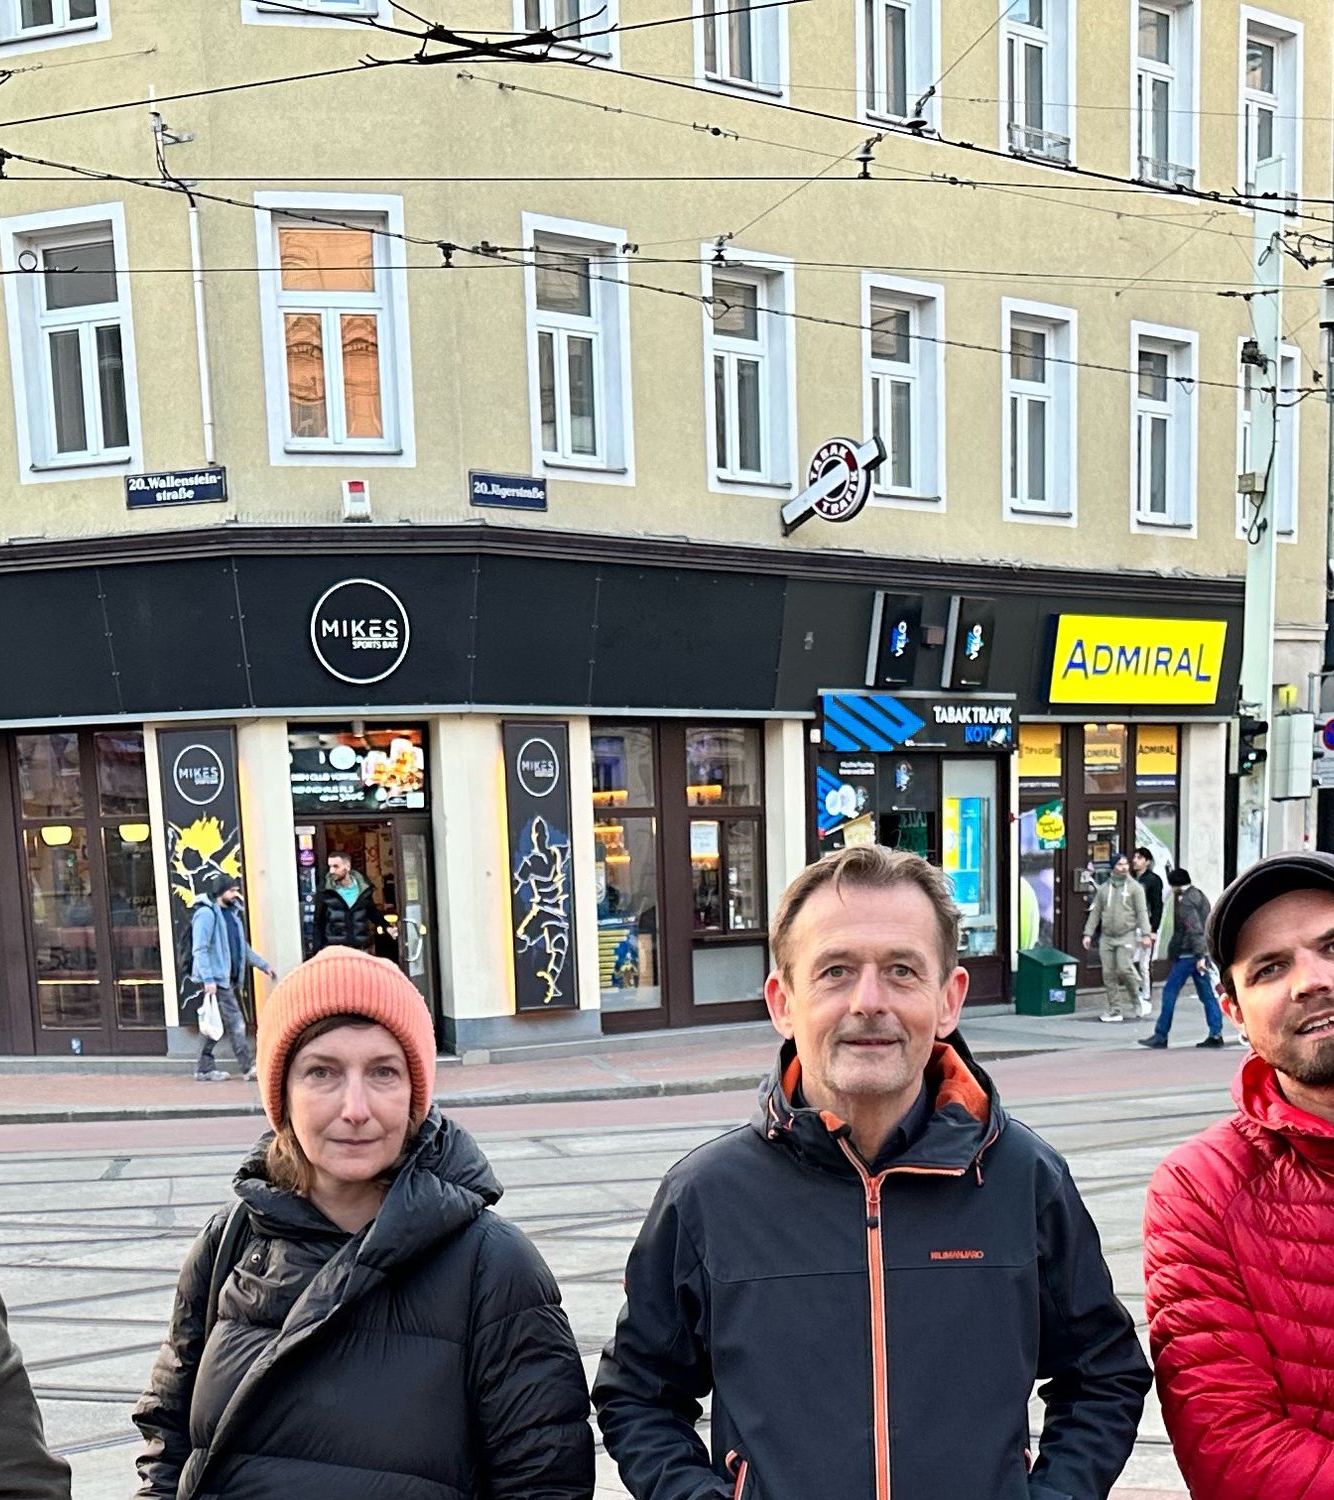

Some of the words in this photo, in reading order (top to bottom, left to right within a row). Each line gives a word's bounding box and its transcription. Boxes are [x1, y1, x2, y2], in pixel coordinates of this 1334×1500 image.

[811, 444, 848, 480] TABAK
[155, 487, 195, 501] straße
[822, 470, 858, 514] TRAFIK
[321, 619, 398, 638] MIKES
[352, 641, 381, 649] SPORTS
[382, 641, 398, 649] BAR
[1061, 639, 1211, 682] ADMIRAL
[933, 706, 971, 724] TABAK
[971, 706, 1013, 724] TRAFIK
[179, 766, 219, 780] MIKES
[522, 760, 555, 772] MIKES
